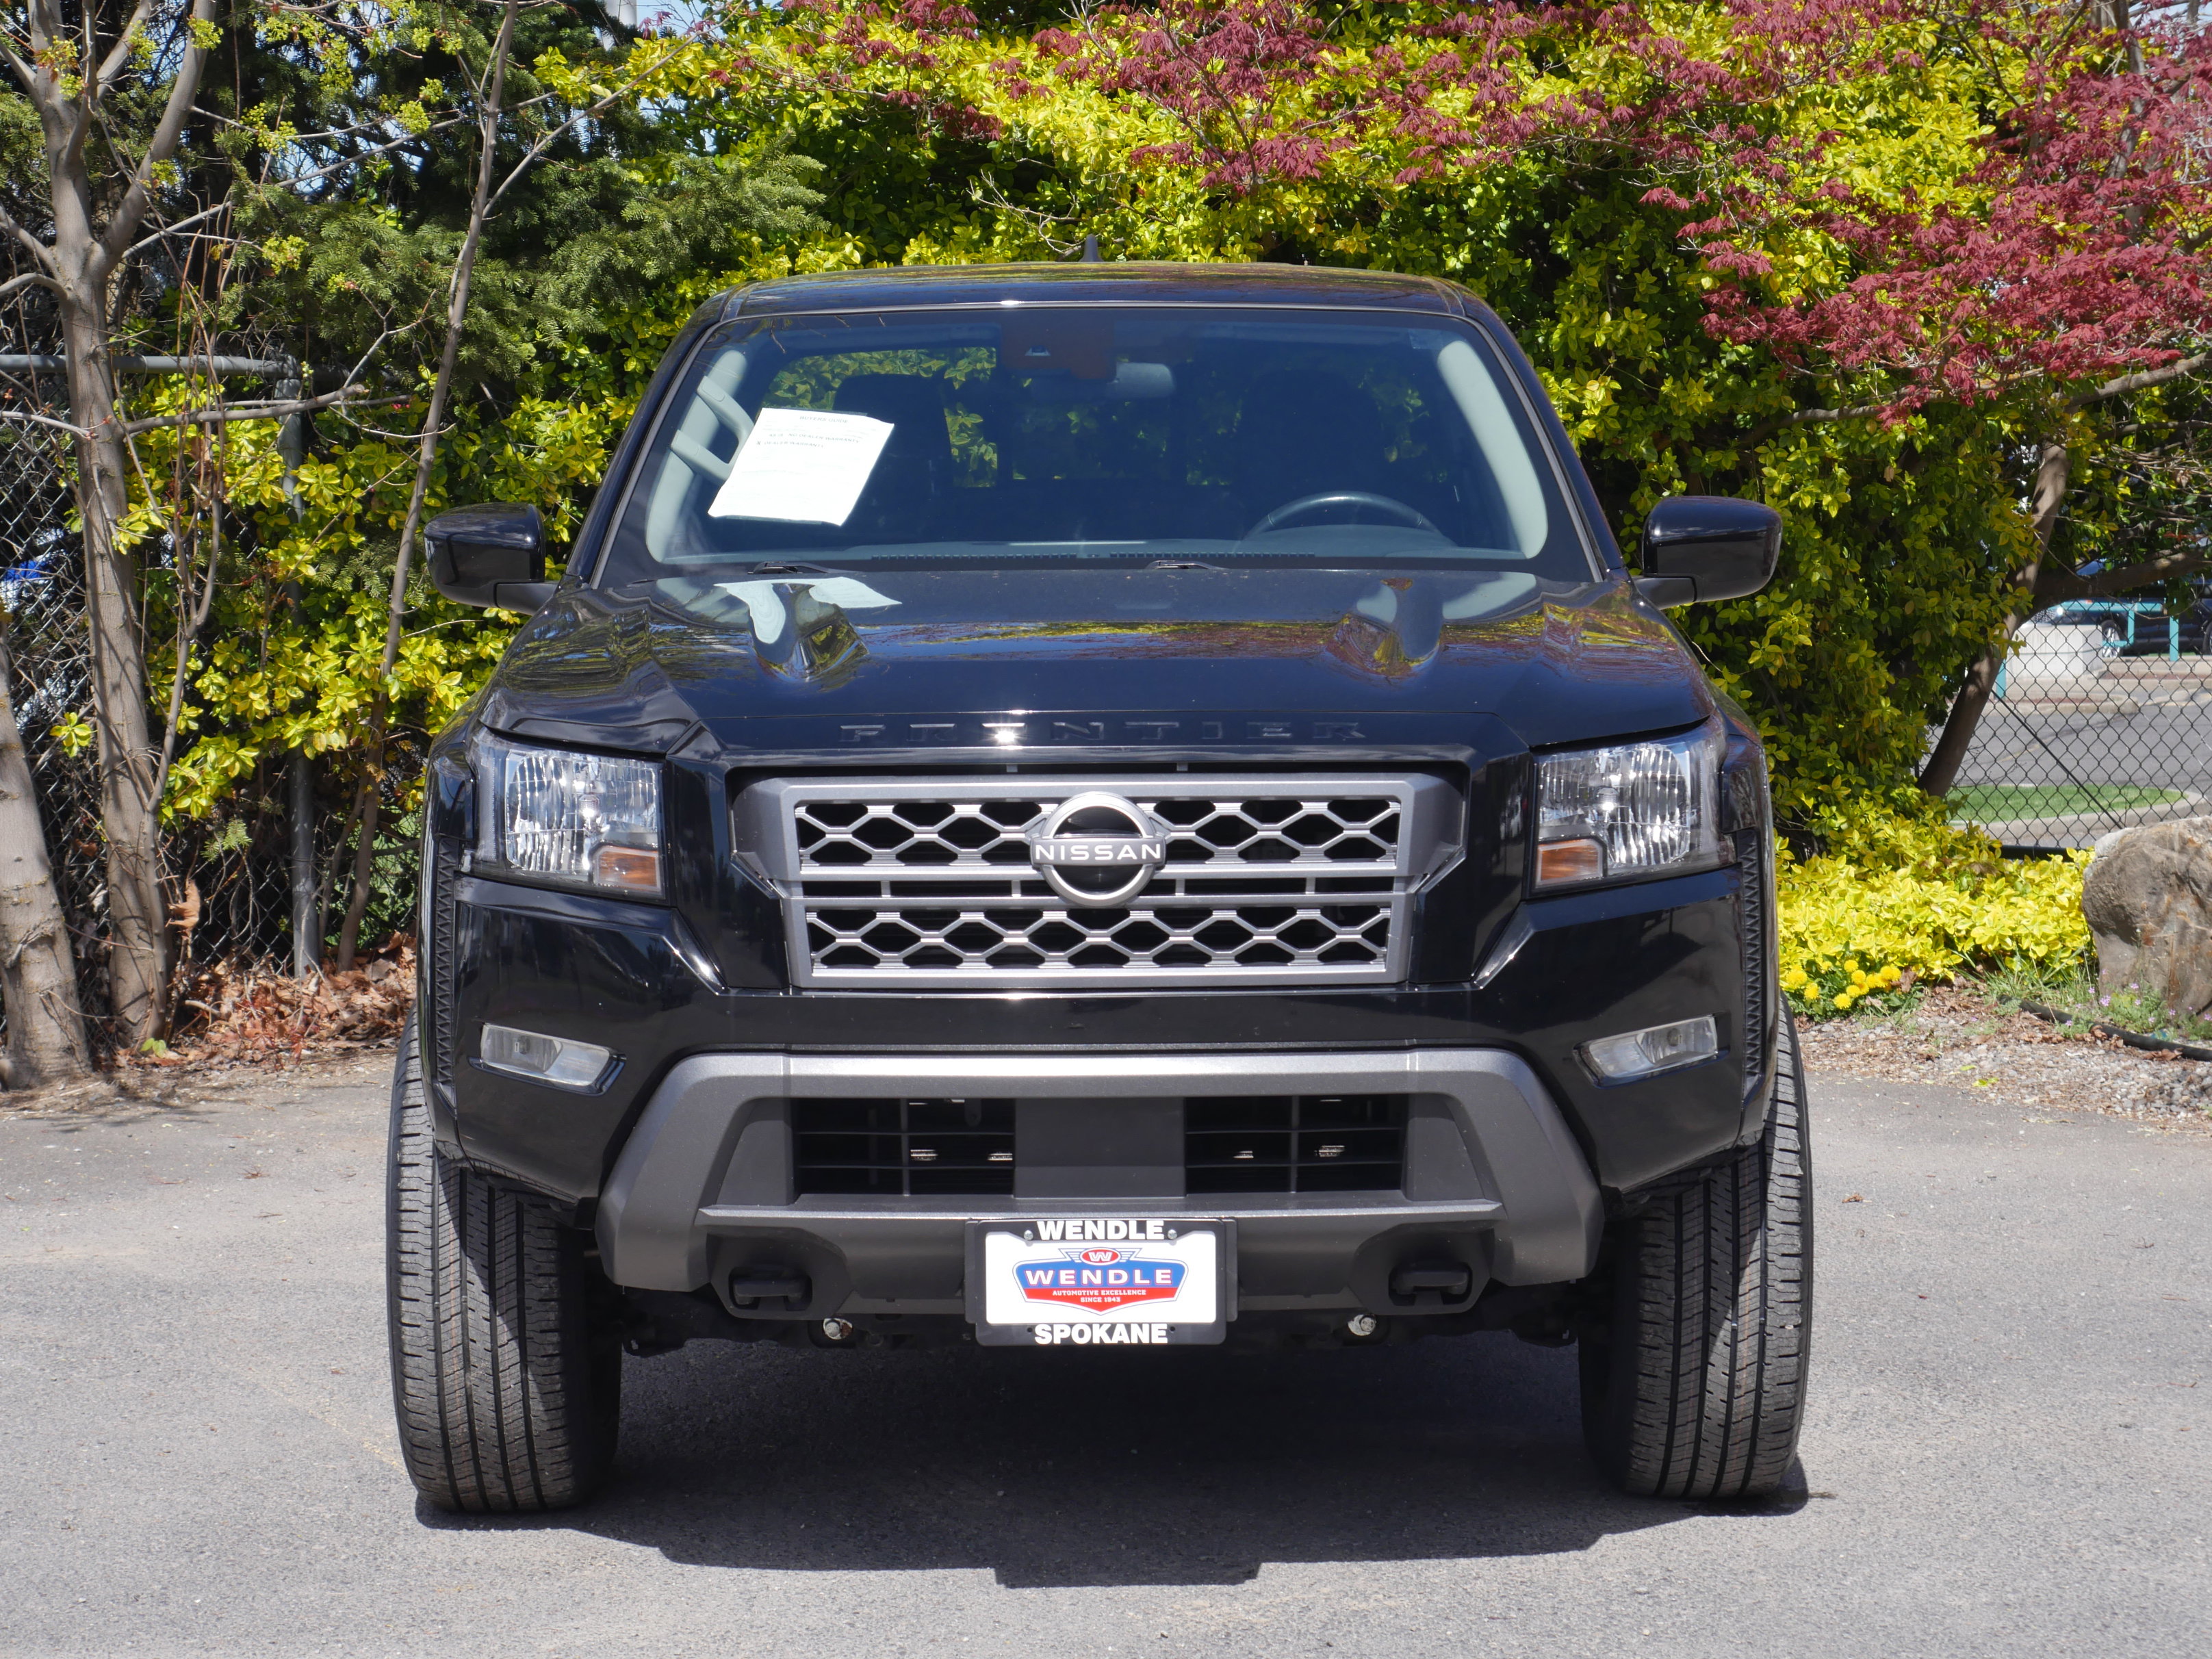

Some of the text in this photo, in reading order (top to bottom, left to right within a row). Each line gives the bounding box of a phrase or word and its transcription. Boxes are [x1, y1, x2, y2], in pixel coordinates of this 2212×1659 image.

[799, 415, 827, 423] BUYERS
[1035, 843, 1161, 861] NISSAN
[1036, 1220, 1165, 1241] WENDLE
[1024, 1270, 1172, 1286] WENDLE
[1034, 1323, 1168, 1346] SPOKANE
